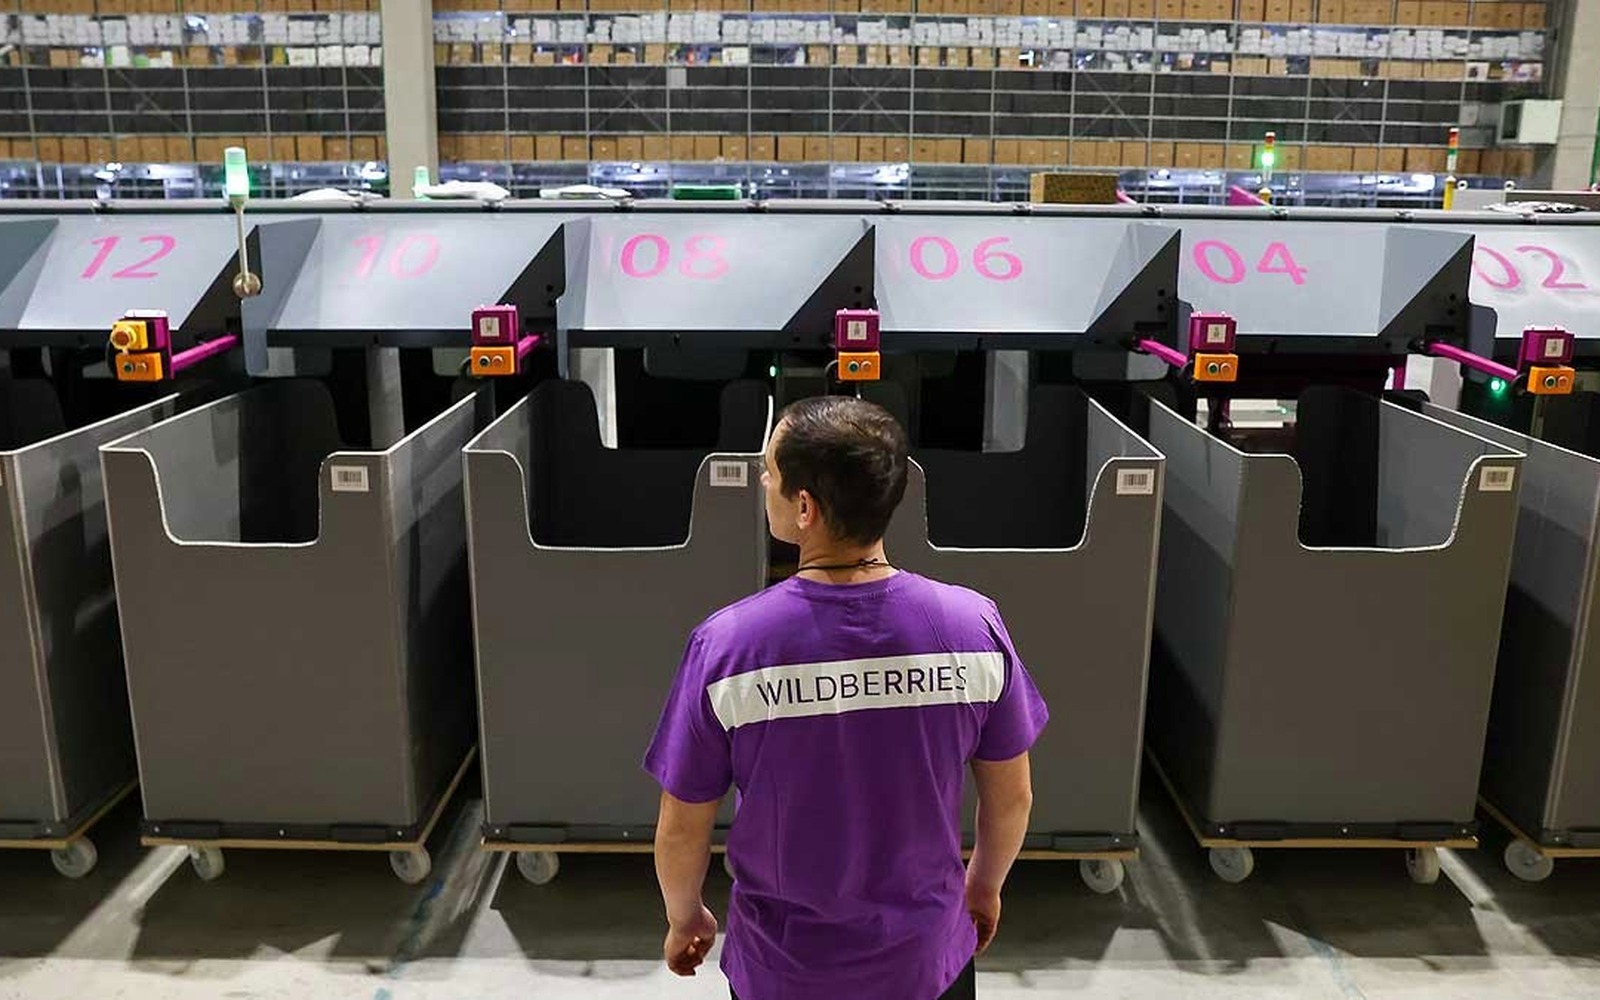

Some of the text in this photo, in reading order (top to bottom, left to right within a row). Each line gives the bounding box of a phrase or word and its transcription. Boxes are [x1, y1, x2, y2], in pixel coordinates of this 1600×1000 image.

[80, 234, 177, 280] 12
[352, 235, 440, 279] 10
[620, 233, 730, 280] 08
[909, 236, 1024, 282] 06
[1192, 240, 1309, 285] 04
[1473, 244, 1588, 290] 02
[757, 666, 967, 707] WILDBERRIES
